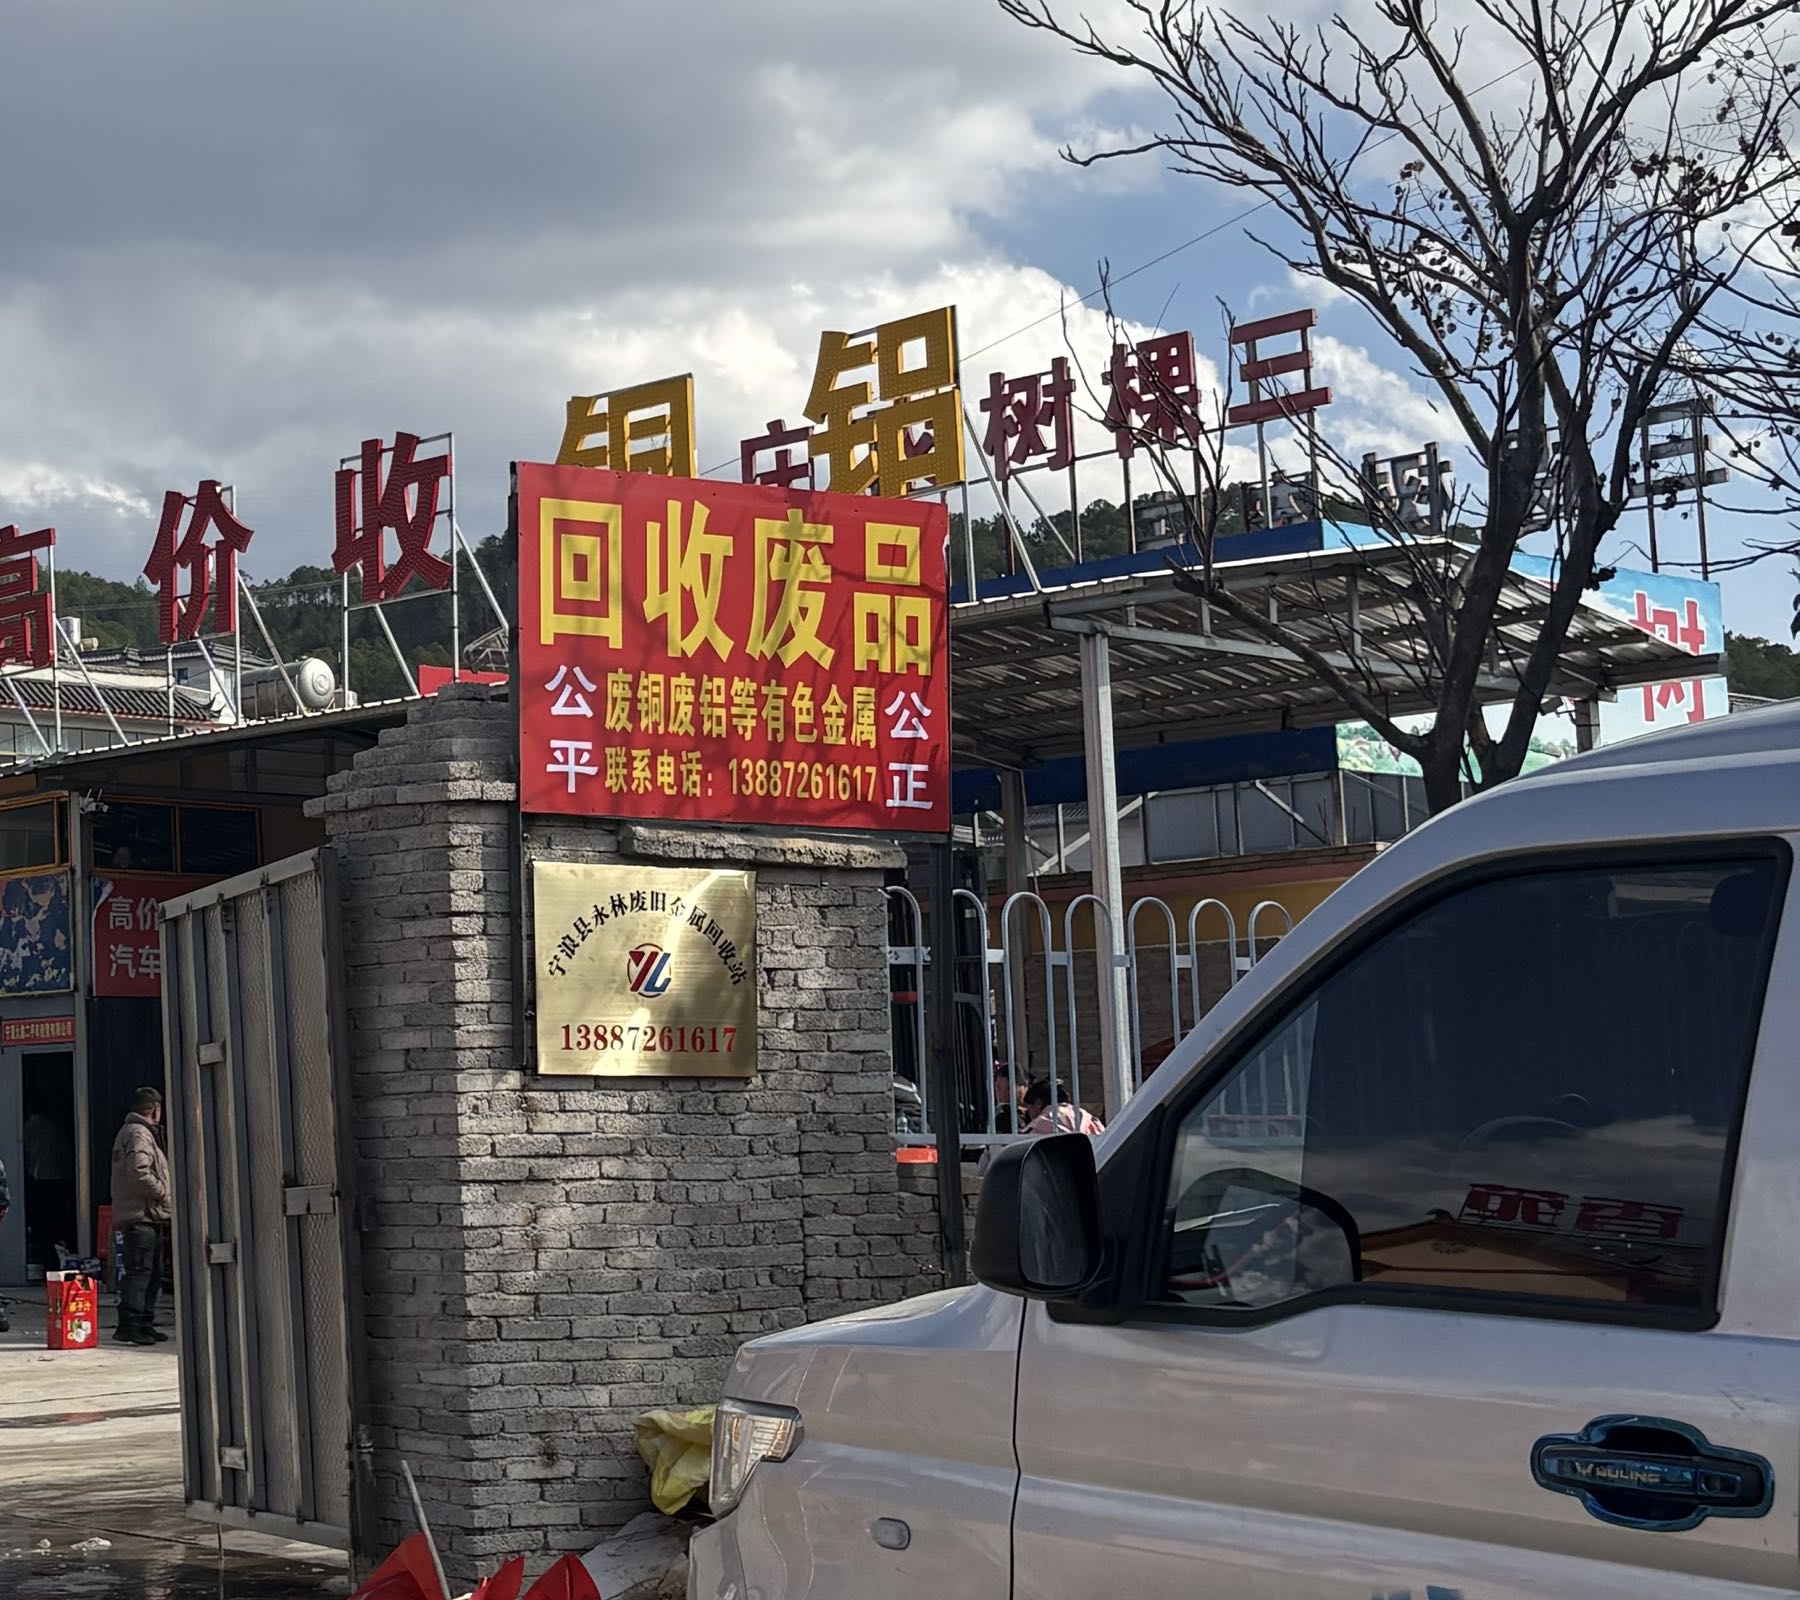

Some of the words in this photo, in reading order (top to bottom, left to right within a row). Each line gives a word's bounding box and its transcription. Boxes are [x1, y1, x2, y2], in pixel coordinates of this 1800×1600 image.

[539, 496, 932, 677] 回收废品
[544, 664, 599, 794] 公平
[604, 666, 878, 749] 废铜废铝等有色金属
[884, 690, 933, 810] 公正
[108, 896, 160, 931] 高价
[109, 943, 162, 979] 汽车
[561, 1023, 737, 1053] 13887261617
